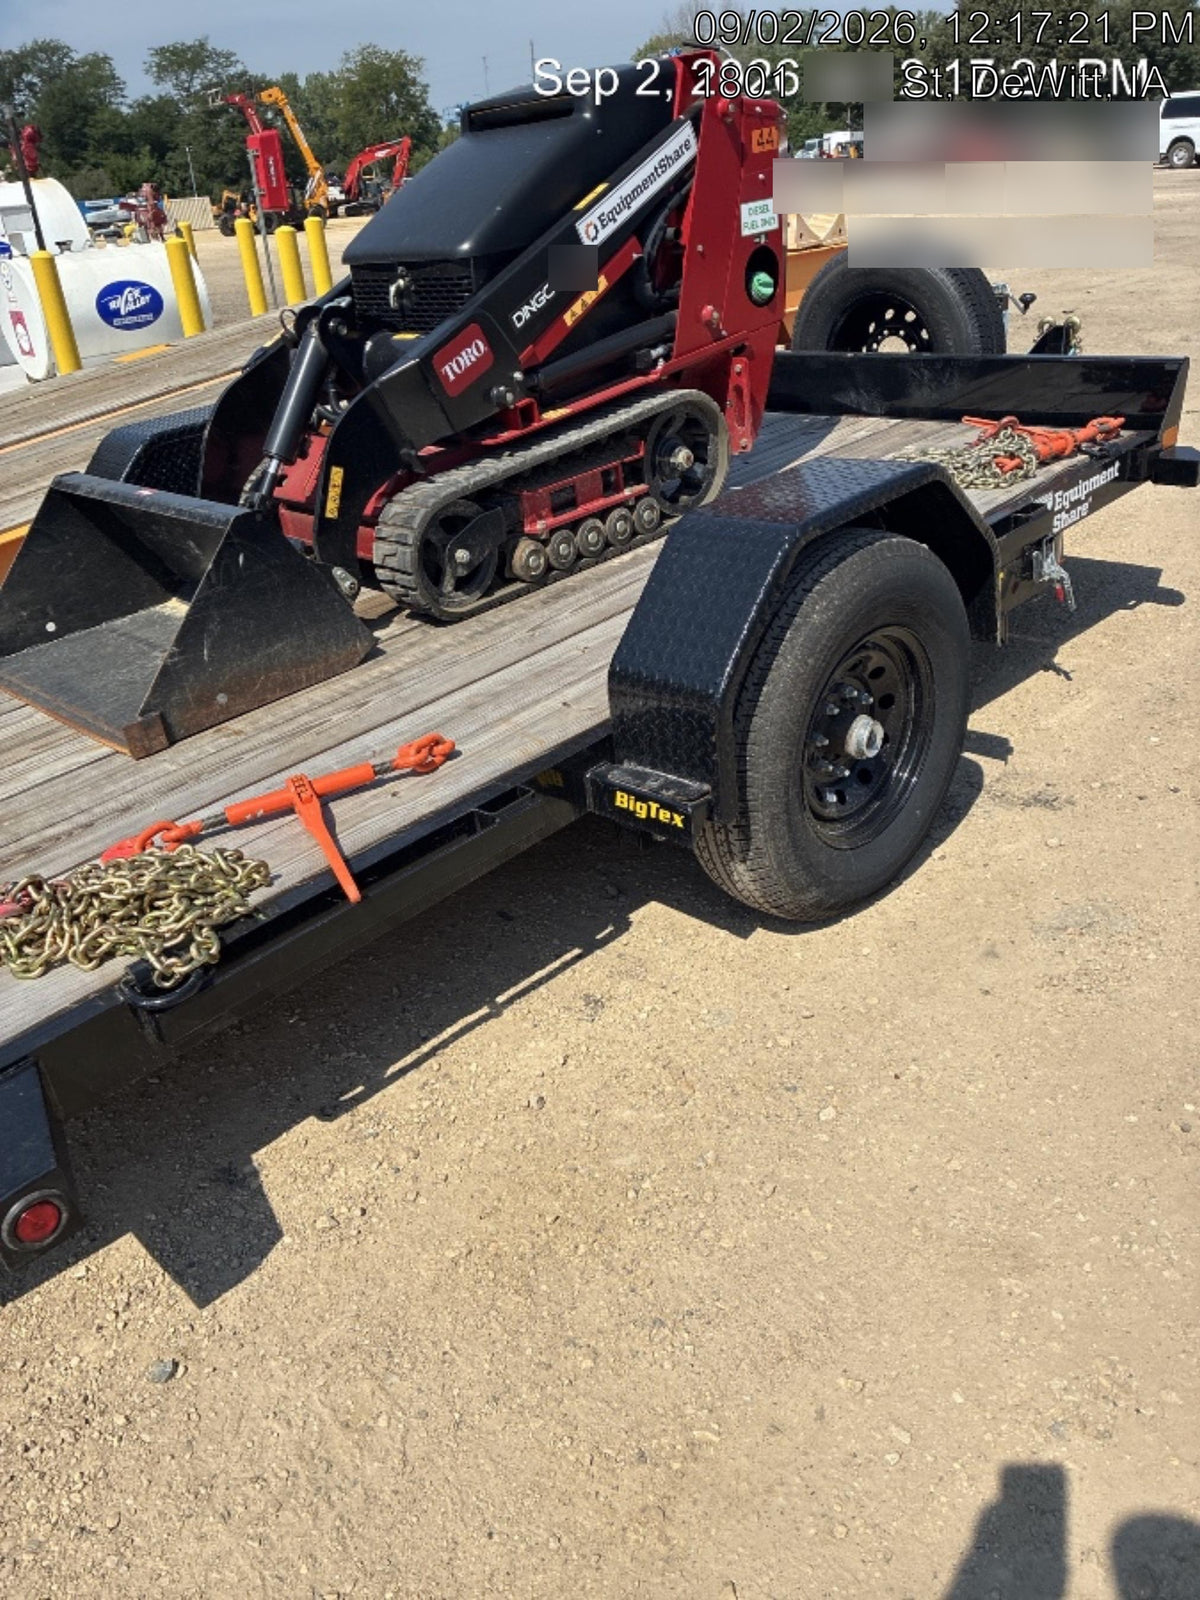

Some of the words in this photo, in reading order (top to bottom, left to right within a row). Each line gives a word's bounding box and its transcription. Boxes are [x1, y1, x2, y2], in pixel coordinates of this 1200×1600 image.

[597, 138, 692, 230] EquipmentShare
[748, 203, 770, 216] DIESEL
[441, 339, 485, 382] TORO
[1054, 460, 1120, 511] Equipment
[1053, 502, 1090, 533] Share
[615, 790, 685, 828] BigTex
